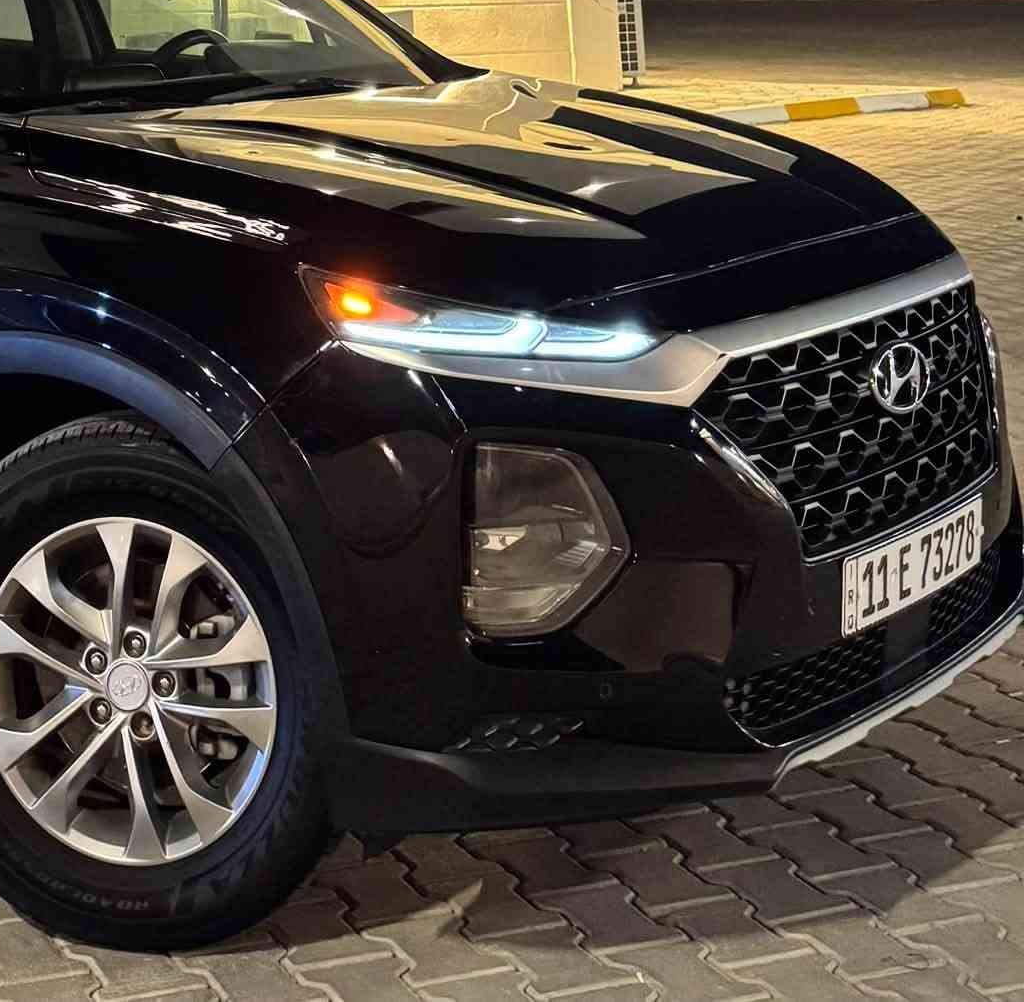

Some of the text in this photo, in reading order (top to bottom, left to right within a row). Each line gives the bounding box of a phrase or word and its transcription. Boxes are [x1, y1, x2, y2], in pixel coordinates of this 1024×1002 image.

[862, 510, 975, 617] 11 E 73278
